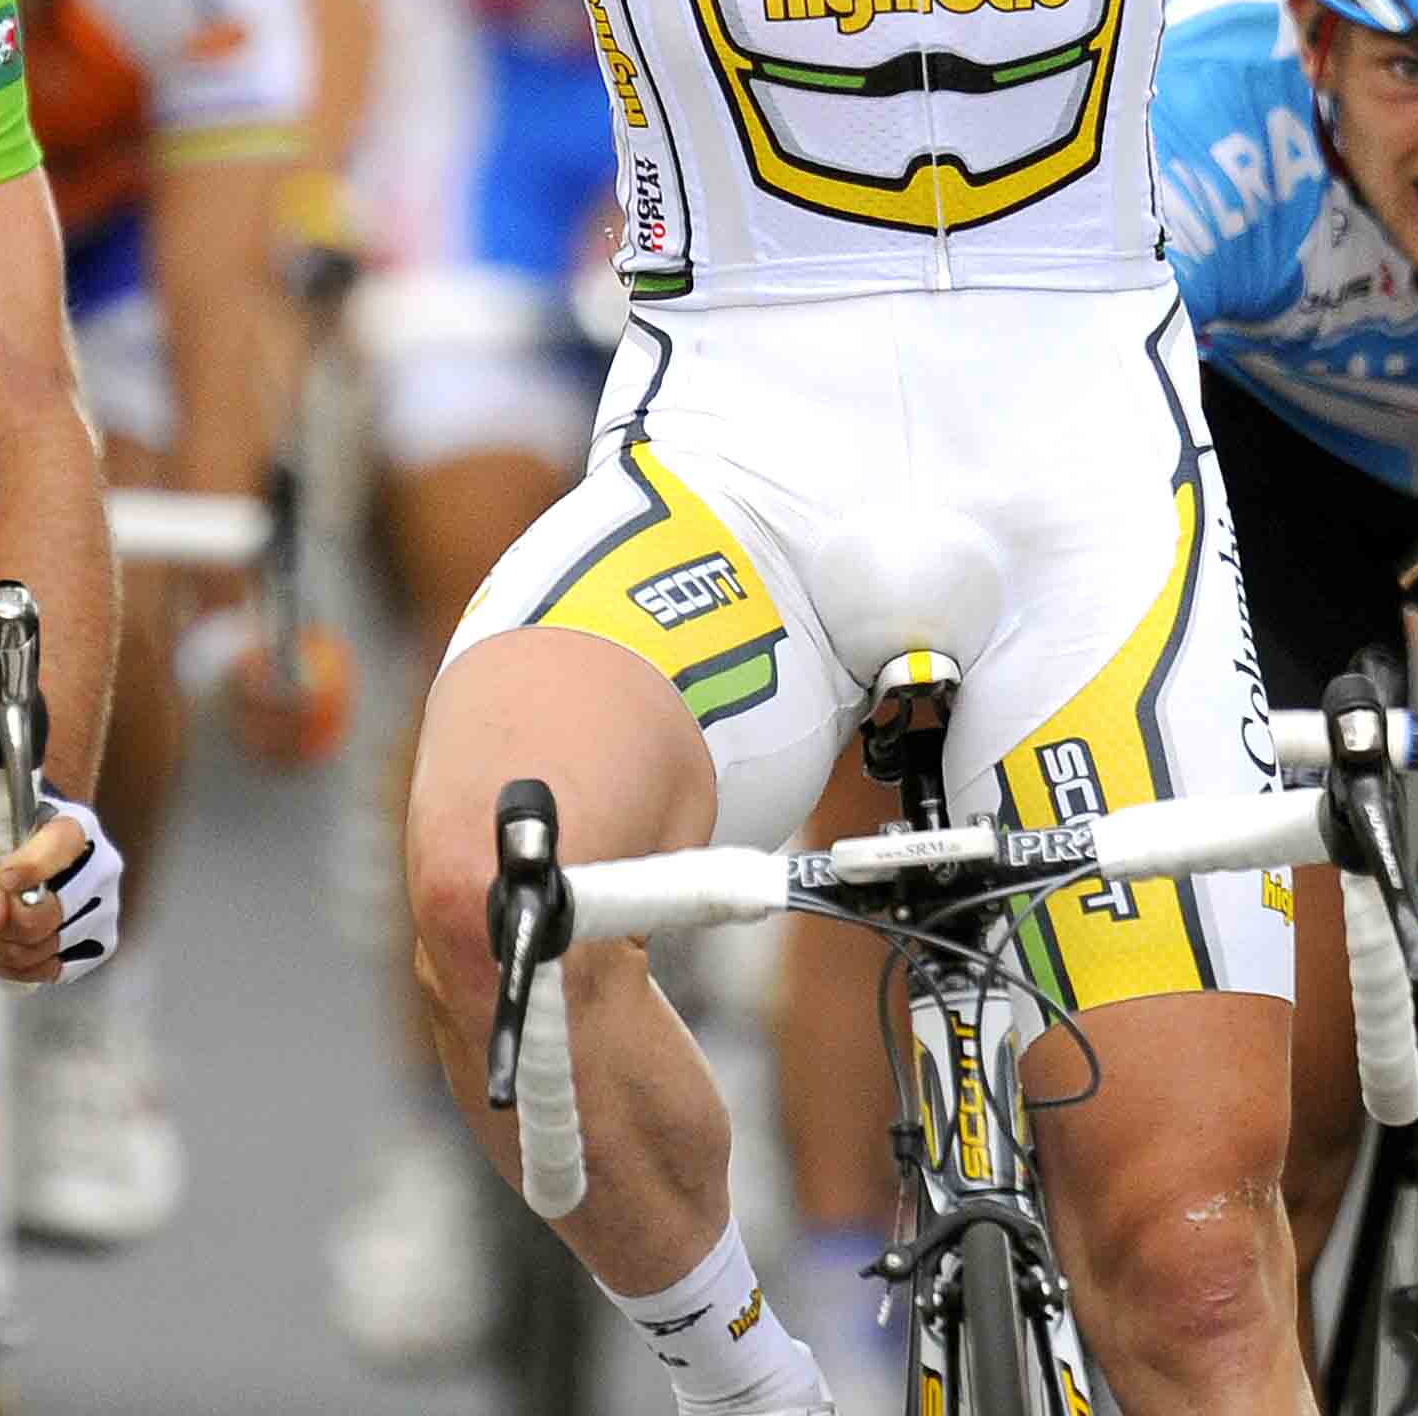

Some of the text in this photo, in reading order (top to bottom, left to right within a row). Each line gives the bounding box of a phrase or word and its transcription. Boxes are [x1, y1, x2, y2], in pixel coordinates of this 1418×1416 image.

[633, 151, 654, 253] RIGHT
[645, 157, 666, 252] TO PLAY
[633, 556, 743, 624] SCOTT
